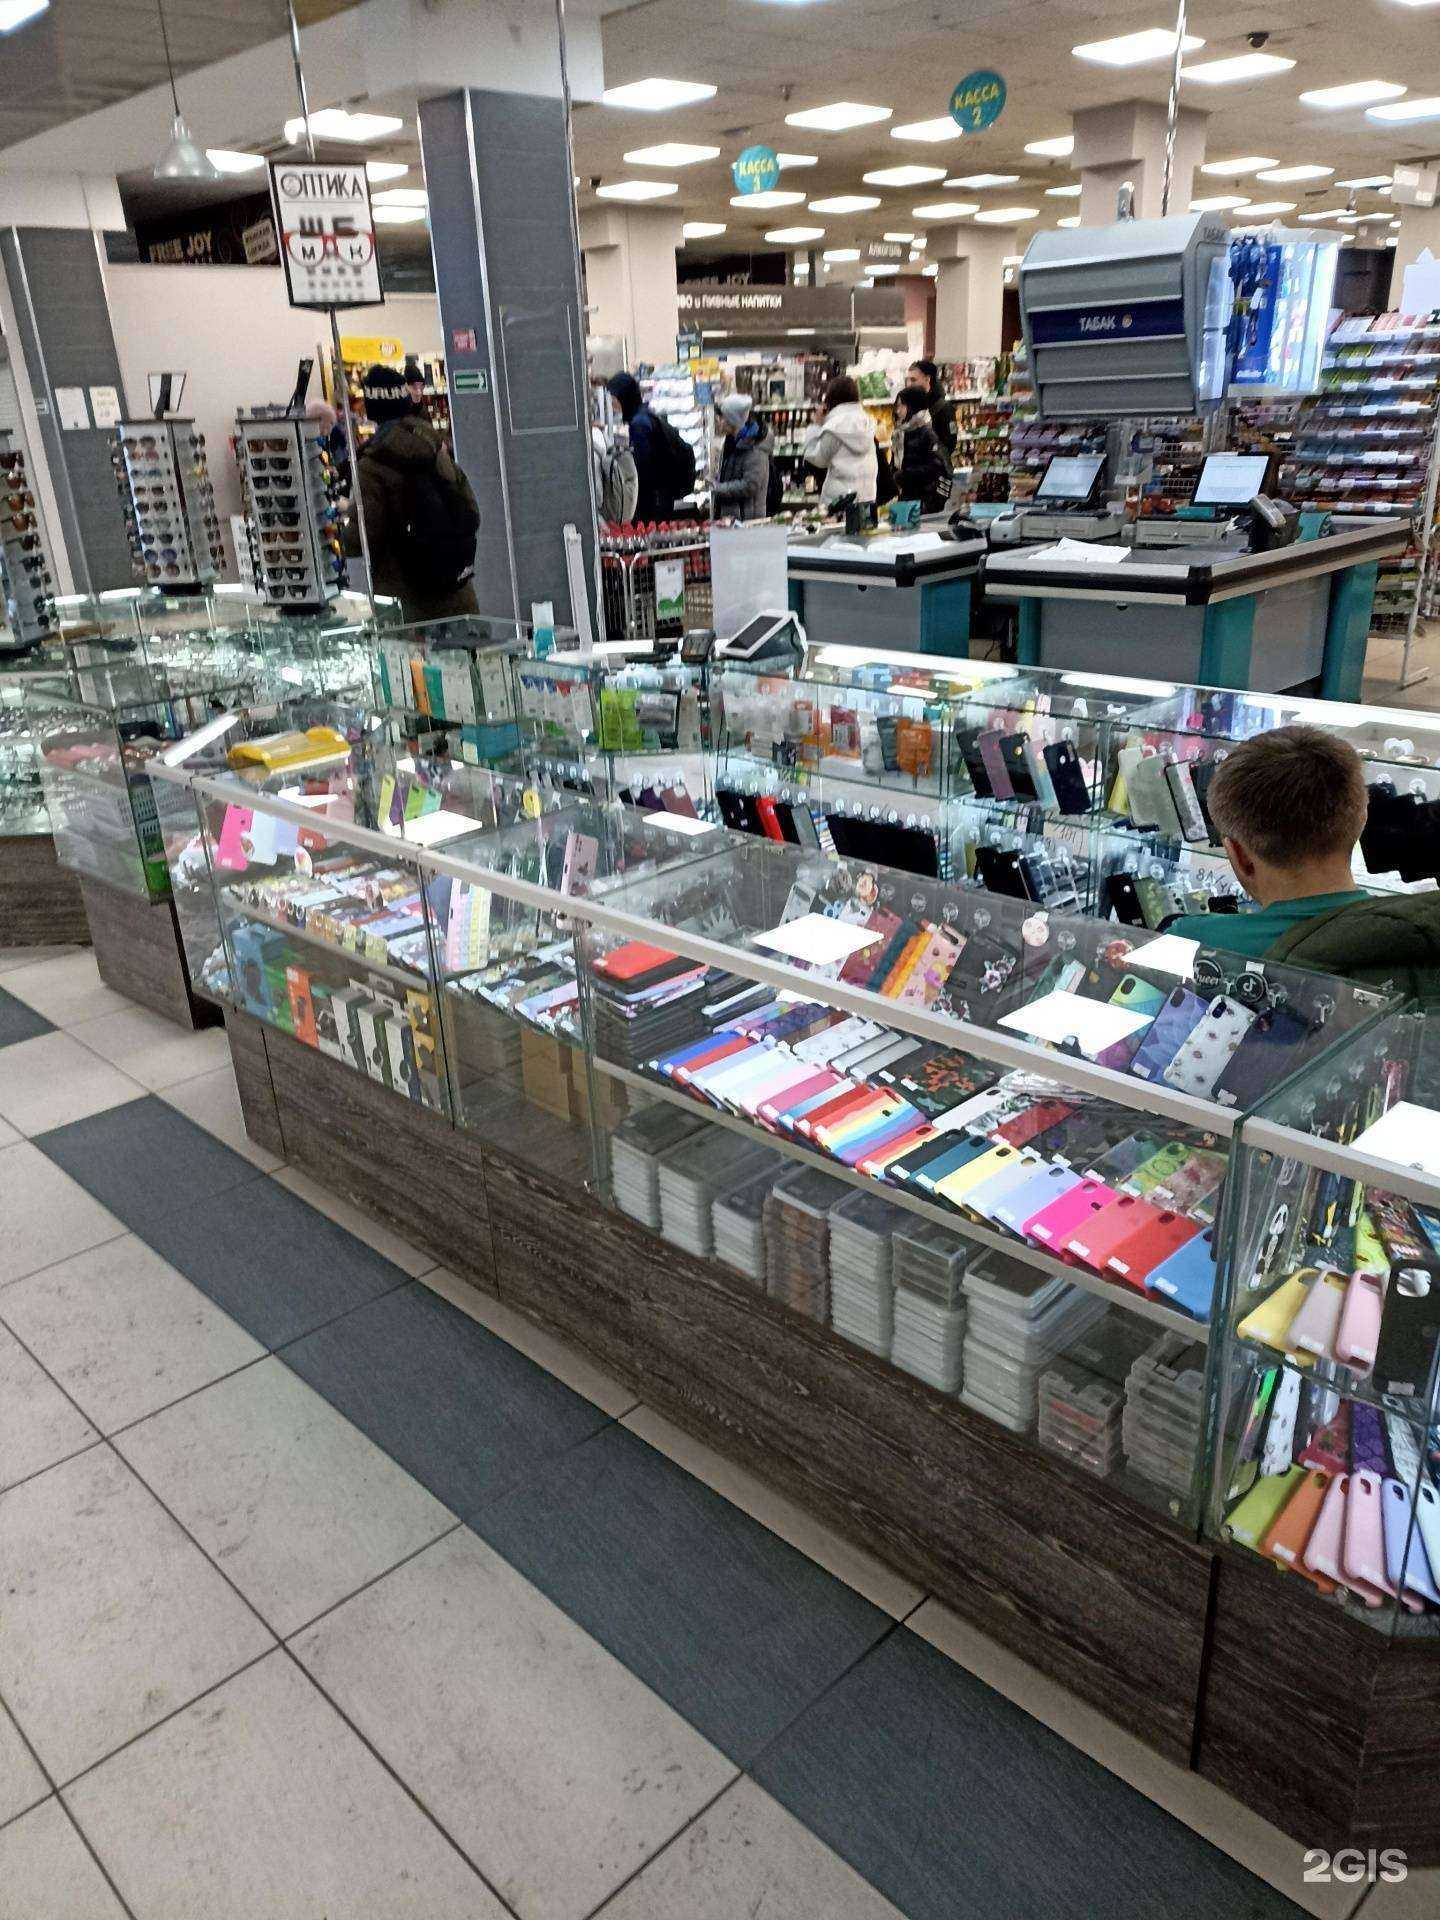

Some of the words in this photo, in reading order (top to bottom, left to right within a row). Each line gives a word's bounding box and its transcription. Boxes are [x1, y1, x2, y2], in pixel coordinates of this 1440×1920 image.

[955, 83, 999, 109] КАССА
[972, 106, 982, 125] 2
[739, 159, 774, 176] КАССА
[281, 173, 363, 200] ОПТИКА
[187, 230, 212, 257] JOY
[741, 294, 782, 309] НАПИТКИ
[1079, 315, 1116, 333] ТАБАК
